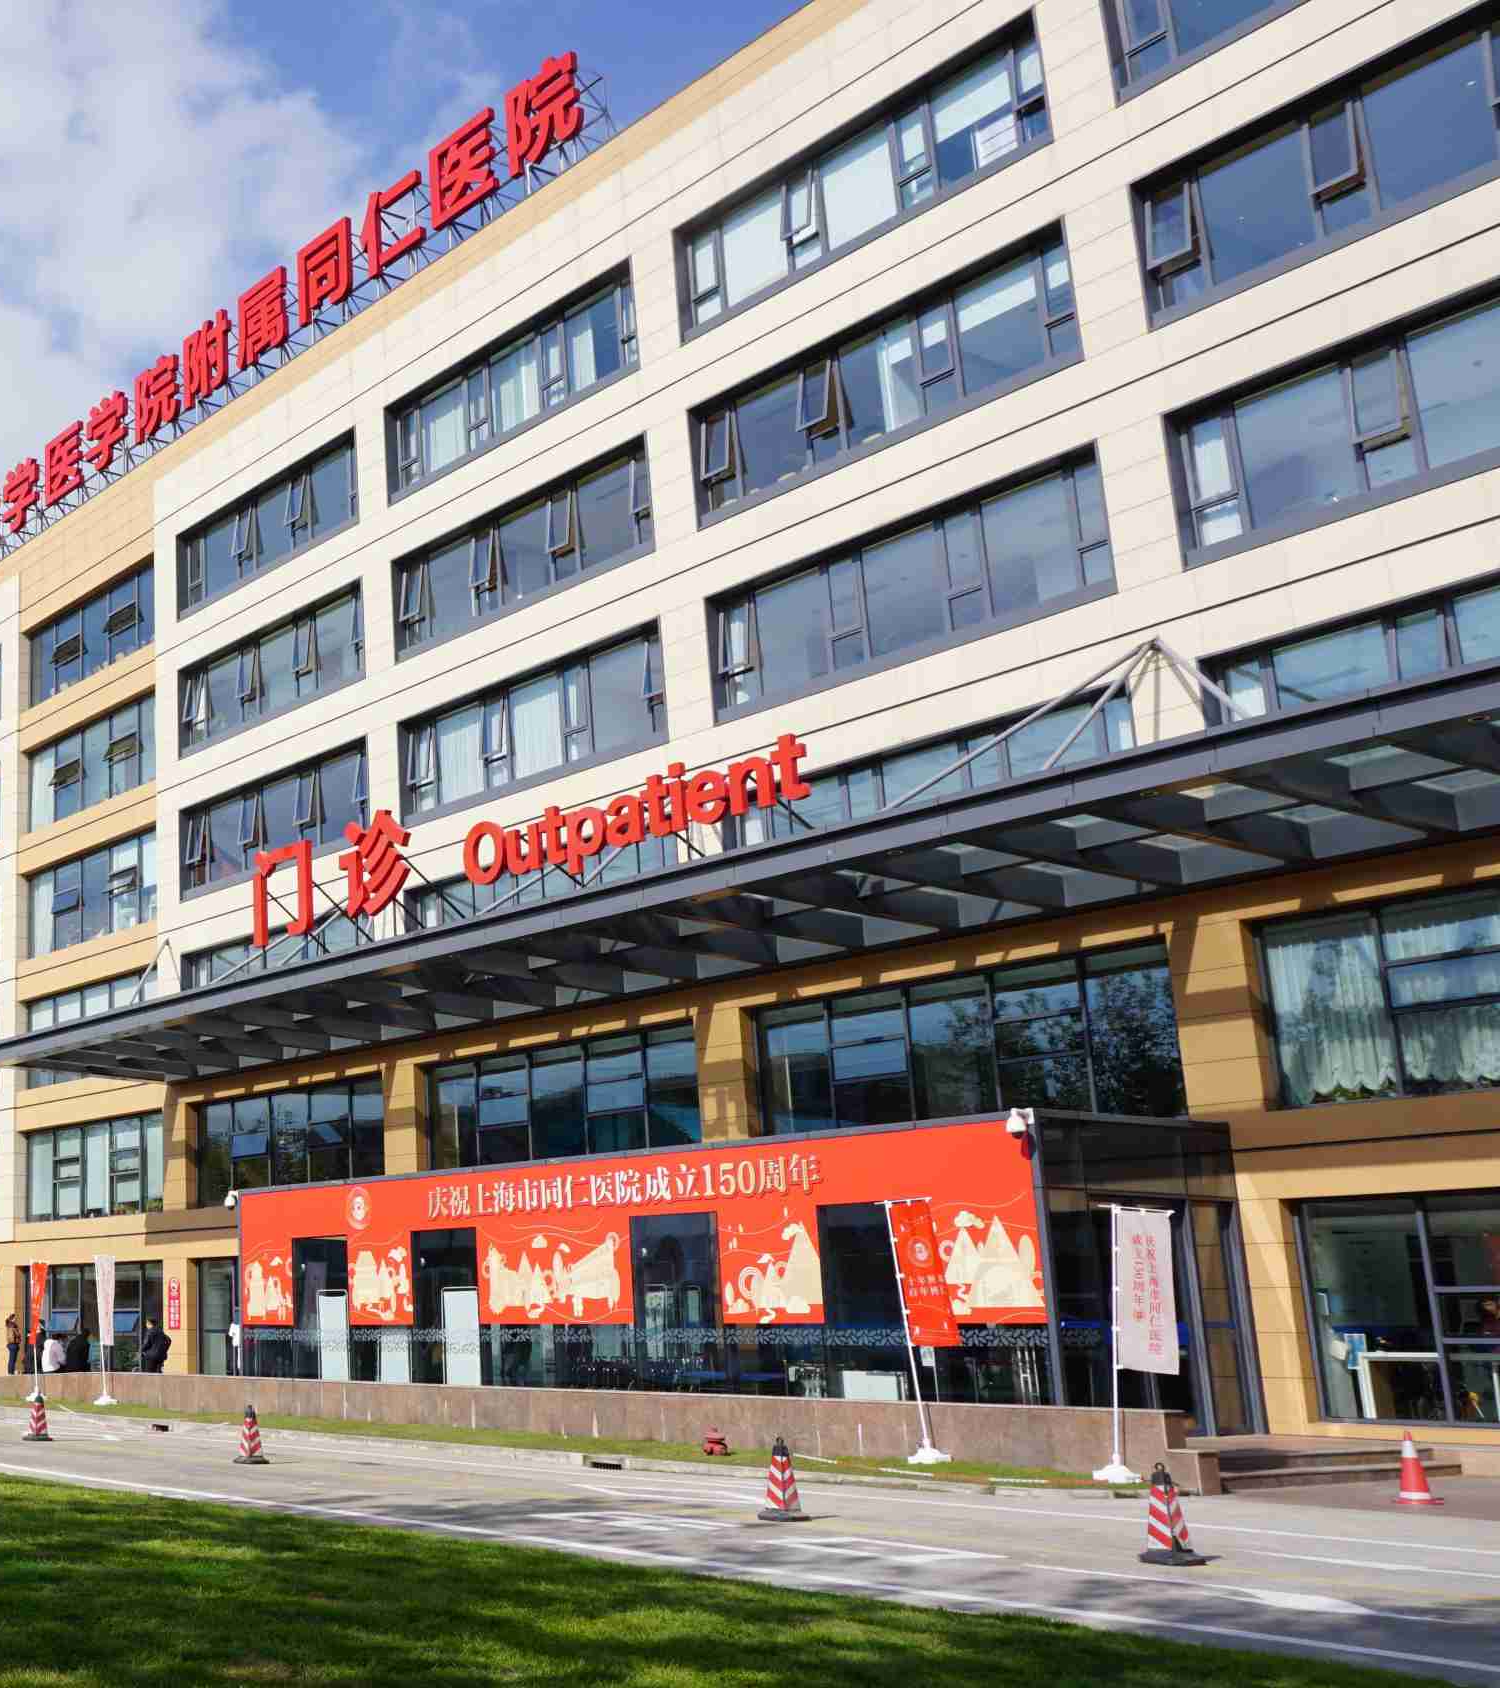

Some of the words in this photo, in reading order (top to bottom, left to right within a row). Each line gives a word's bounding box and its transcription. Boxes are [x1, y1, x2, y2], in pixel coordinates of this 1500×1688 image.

[252, 809, 411, 948] 门诊
[463, 734, 811, 886] Outpatient
[427, 1153, 823, 1219] 庆祝上海市同仁医院成立150周年
